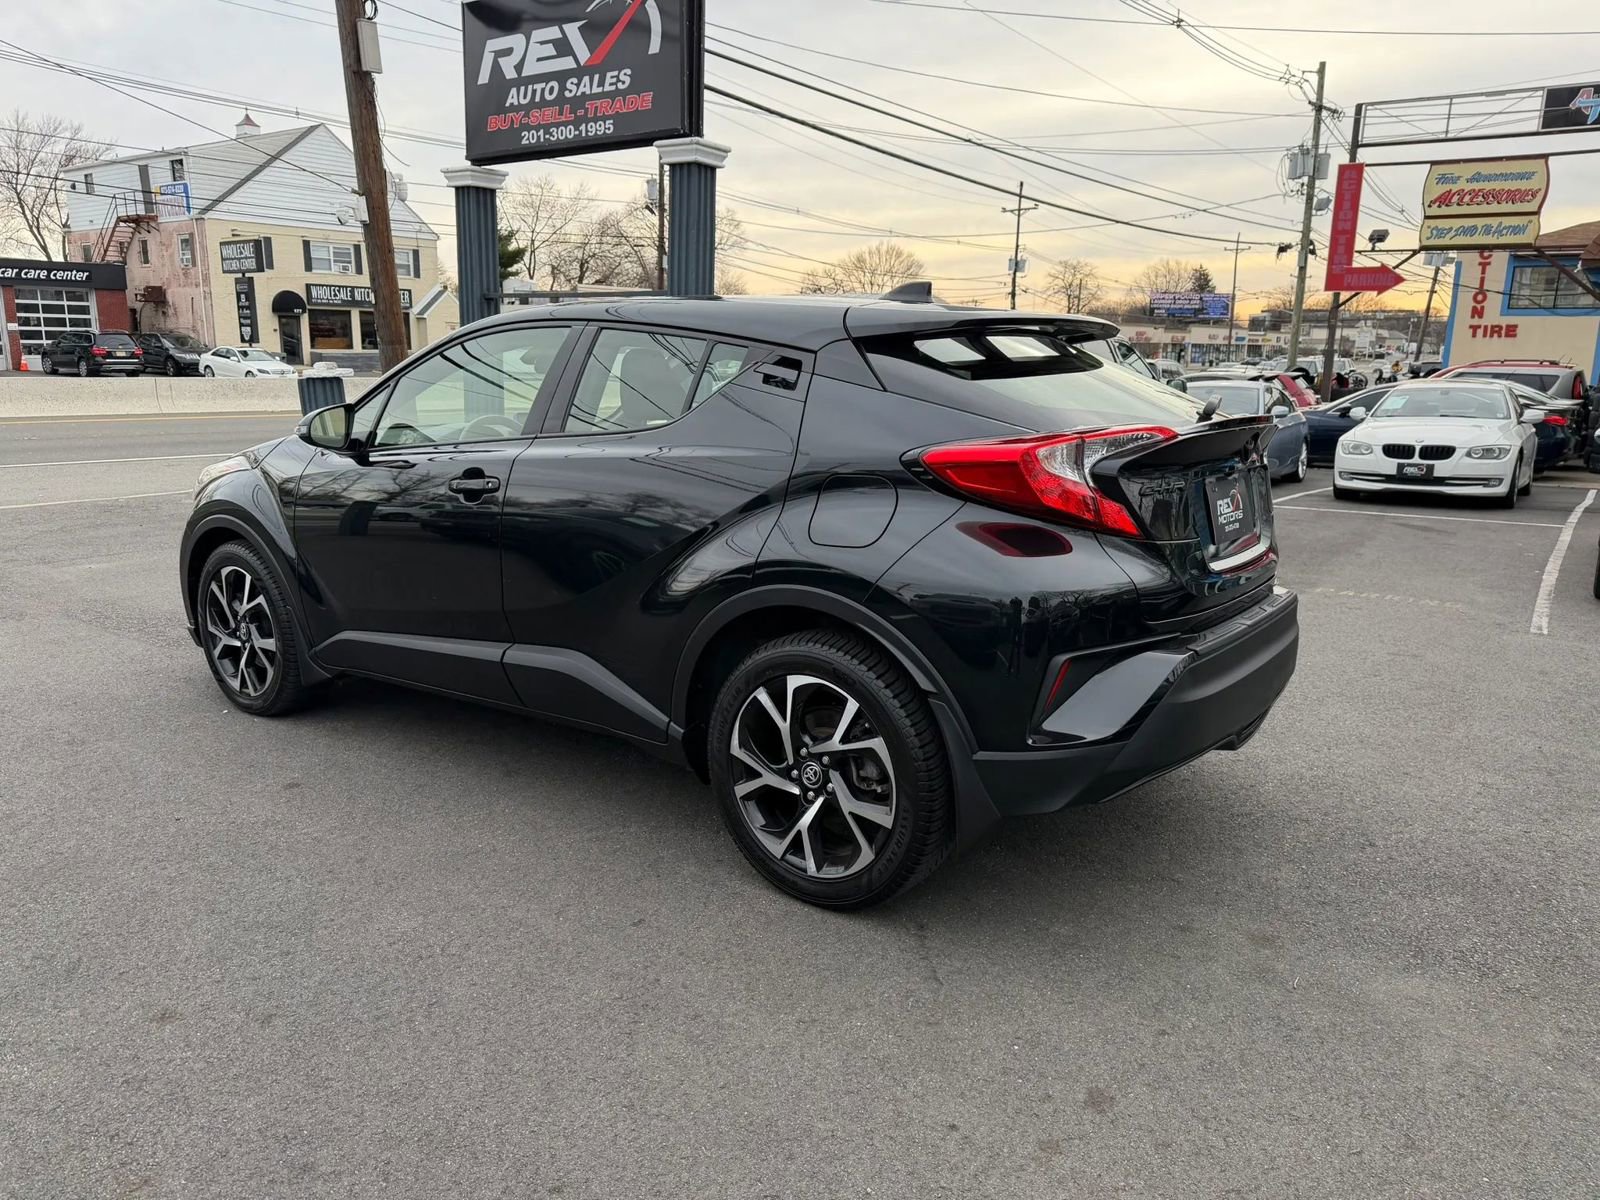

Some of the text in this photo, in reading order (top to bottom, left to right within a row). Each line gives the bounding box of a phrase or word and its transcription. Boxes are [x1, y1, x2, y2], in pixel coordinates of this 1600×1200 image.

[505, 68, 632, 107] AUTO SALES
[520, 119, 614, 145] 201-300-1995
[1428, 187, 1542, 209] ACCESSORIES
[221, 242, 255, 258] WHOLESALE
[223, 258, 257, 270] KITCHEN CENTER
[0, 268, 89, 281] car care center
[1343, 273, 1395, 287] PARKING
[310, 285, 372, 301] WHOLESALE KITC
[1470, 251, 1493, 319] CTION
[1469, 324, 1519, 338] TIRE
[1218, 510, 1243, 525] MOTORS
